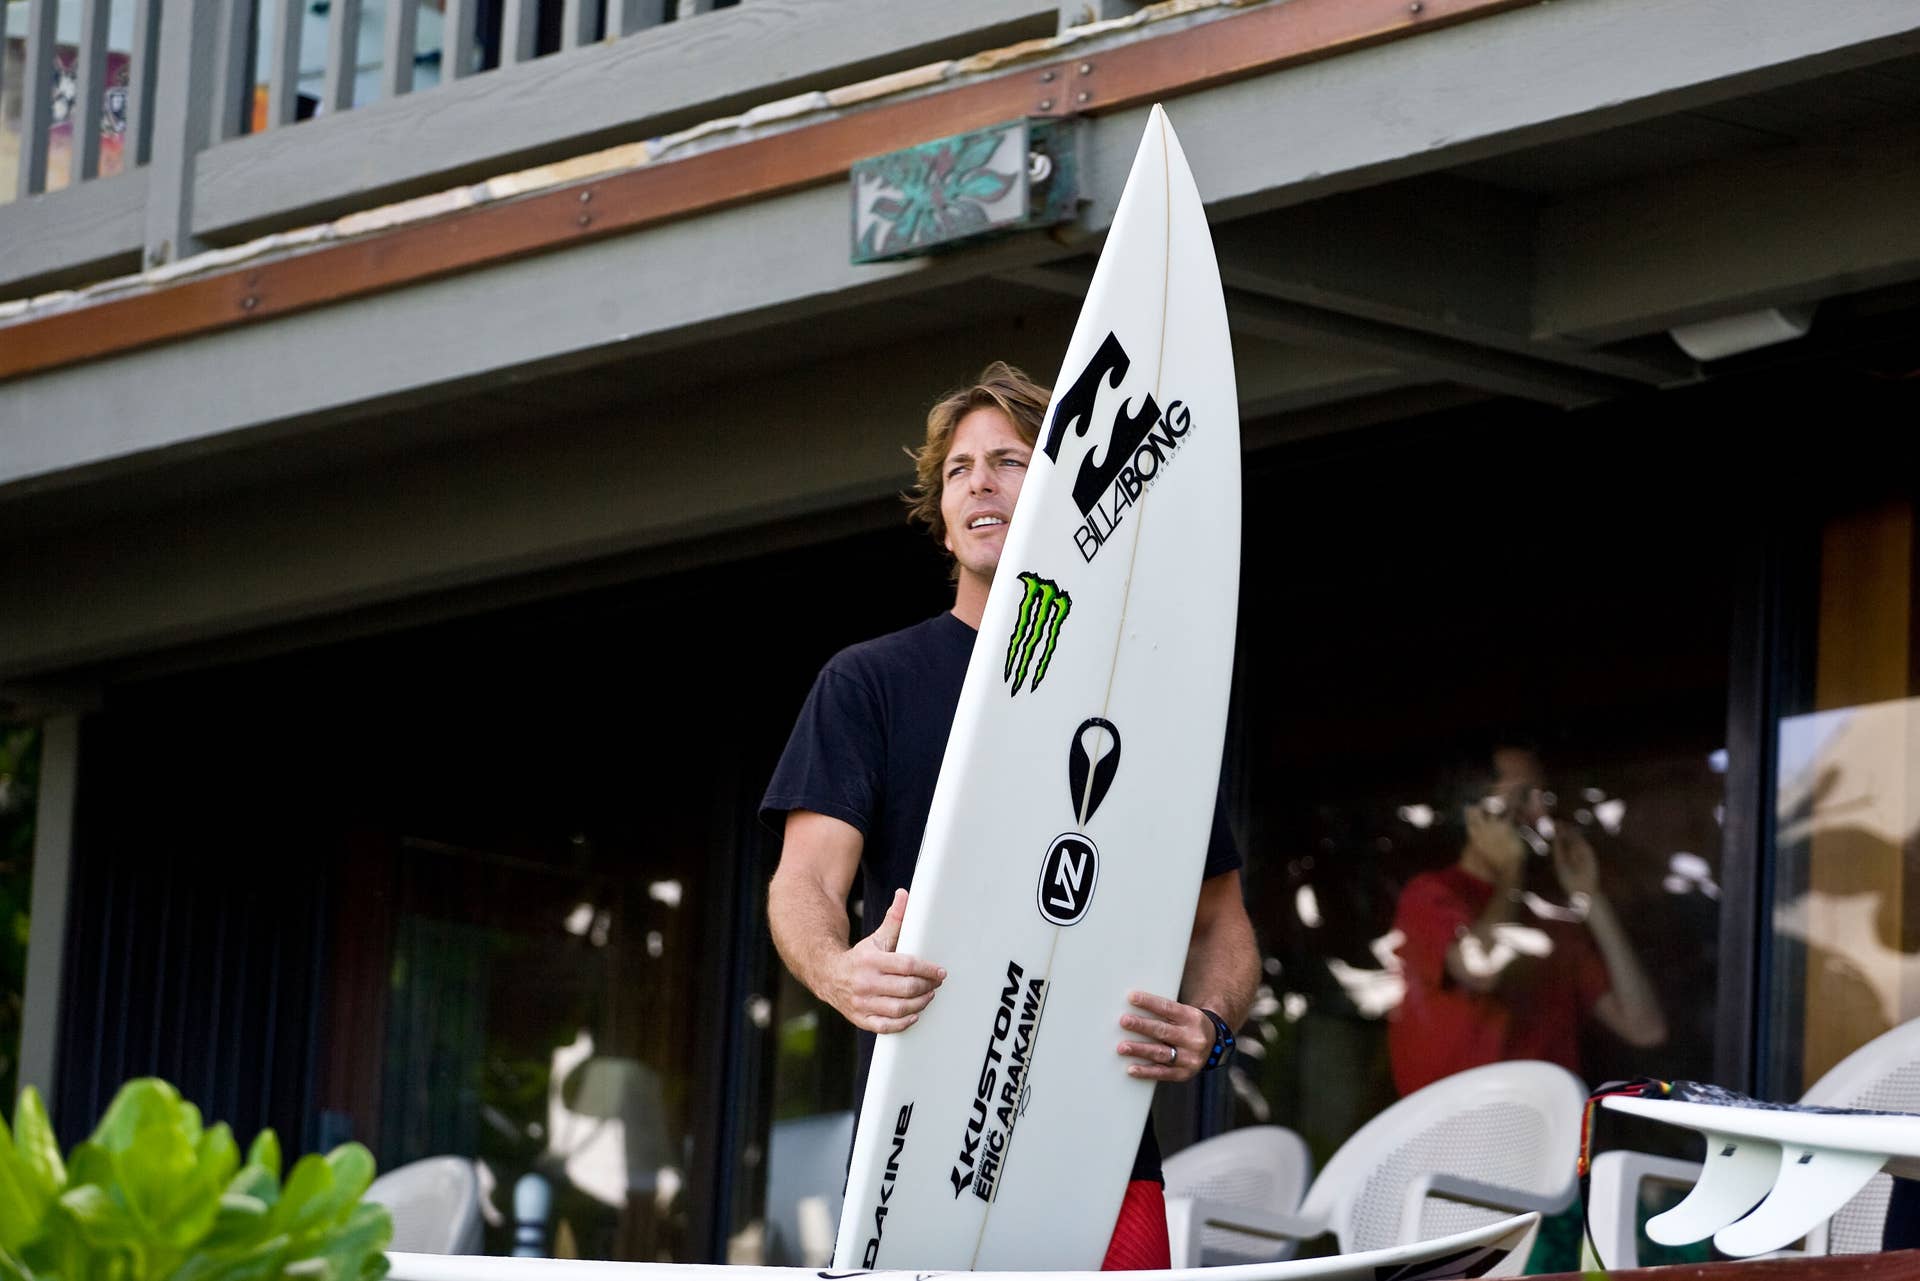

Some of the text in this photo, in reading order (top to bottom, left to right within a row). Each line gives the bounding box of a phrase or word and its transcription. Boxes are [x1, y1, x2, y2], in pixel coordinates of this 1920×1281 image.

[1073, 400, 1191, 563] BILLABONG
[959, 960, 1024, 1168] KUSTOM
[975, 979, 1045, 1203] ERIC ARAKAWA
[862, 1101, 914, 1270] DAKINE
